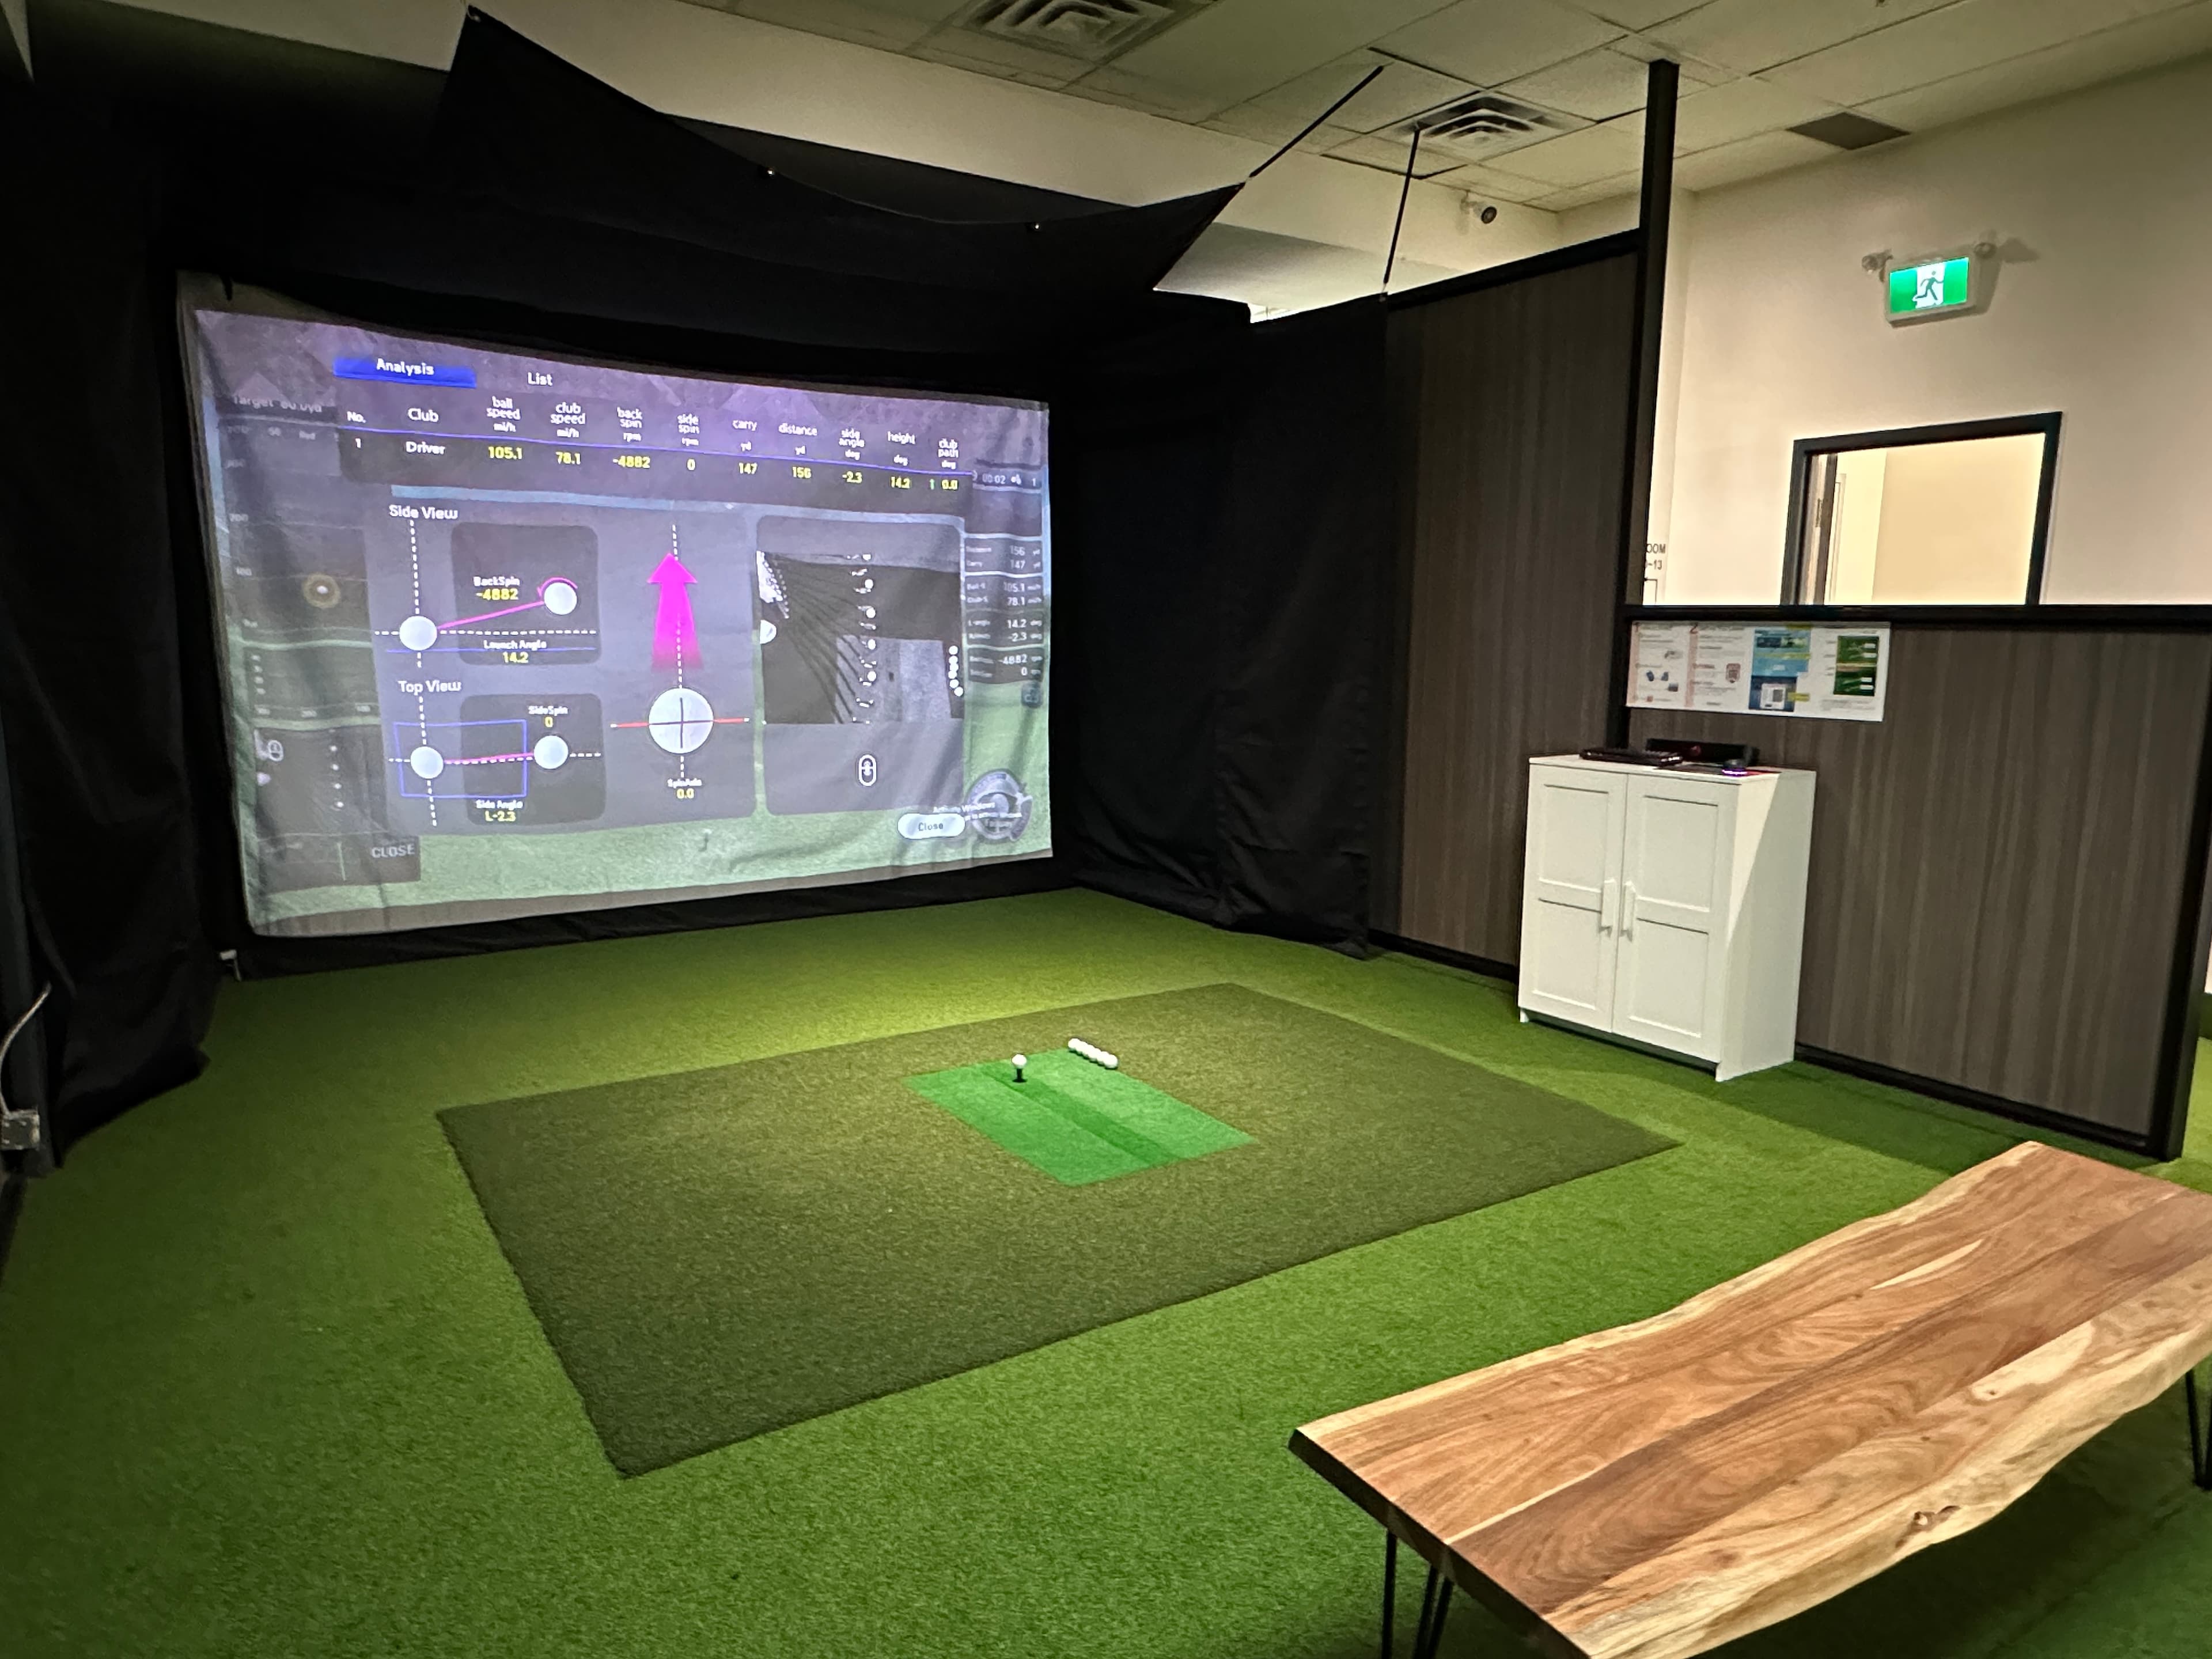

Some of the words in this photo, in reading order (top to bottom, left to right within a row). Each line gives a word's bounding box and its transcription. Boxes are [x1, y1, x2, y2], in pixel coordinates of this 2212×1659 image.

[376, 358, 435, 376] Analysis
[528, 372, 553, 387] List
[491, 395, 513, 410] ball
[555, 402, 582, 414] club
[347, 411, 366, 423] No.
[407, 407, 440, 422] Club
[486, 407, 521, 421] speed
[550, 412, 586, 425] speed
[616, 407, 643, 420] back
[677, 413, 699, 426] side
[619, 418, 642, 429] spin
[677, 423, 700, 434] spin
[732, 419, 757, 431] carry
[778, 422, 818, 437] distance
[887, 431, 915, 445] height
[938, 448, 959, 459] path
[355, 438, 361, 448] 1
[405, 441, 445, 454] Driver
[488, 446, 522, 460] 105.1
[556, 451, 581, 465] 78.1
[612, 455, 651, 469] -4882
[687, 459, 696, 471] 0
[738, 462, 757, 475] 147
[842, 471, 862, 484] -2.3
[891, 476, 911, 489] 14.2
[389, 504, 419, 518] Side
[421, 506, 459, 520] View
[1646, 543, 1666, 554] OOM
[1646, 559, 1662, 570] -13
[473, 575, 520, 588] BackSpin
[476, 588, 519, 601] -4882
[1007, 596, 1025, 605] 78.1
[519, 639, 547, 652] Angle
[502, 651, 529, 664] 14.2
[1020, 666, 1028, 676] 0
[397, 680, 423, 696] Top
[425, 680, 462, 693] View
[544, 716, 554, 728] 0
[676, 787, 695, 800] 0.0
[918, 823, 944, 832] Close
[370, 844, 415, 859] CLOSE
